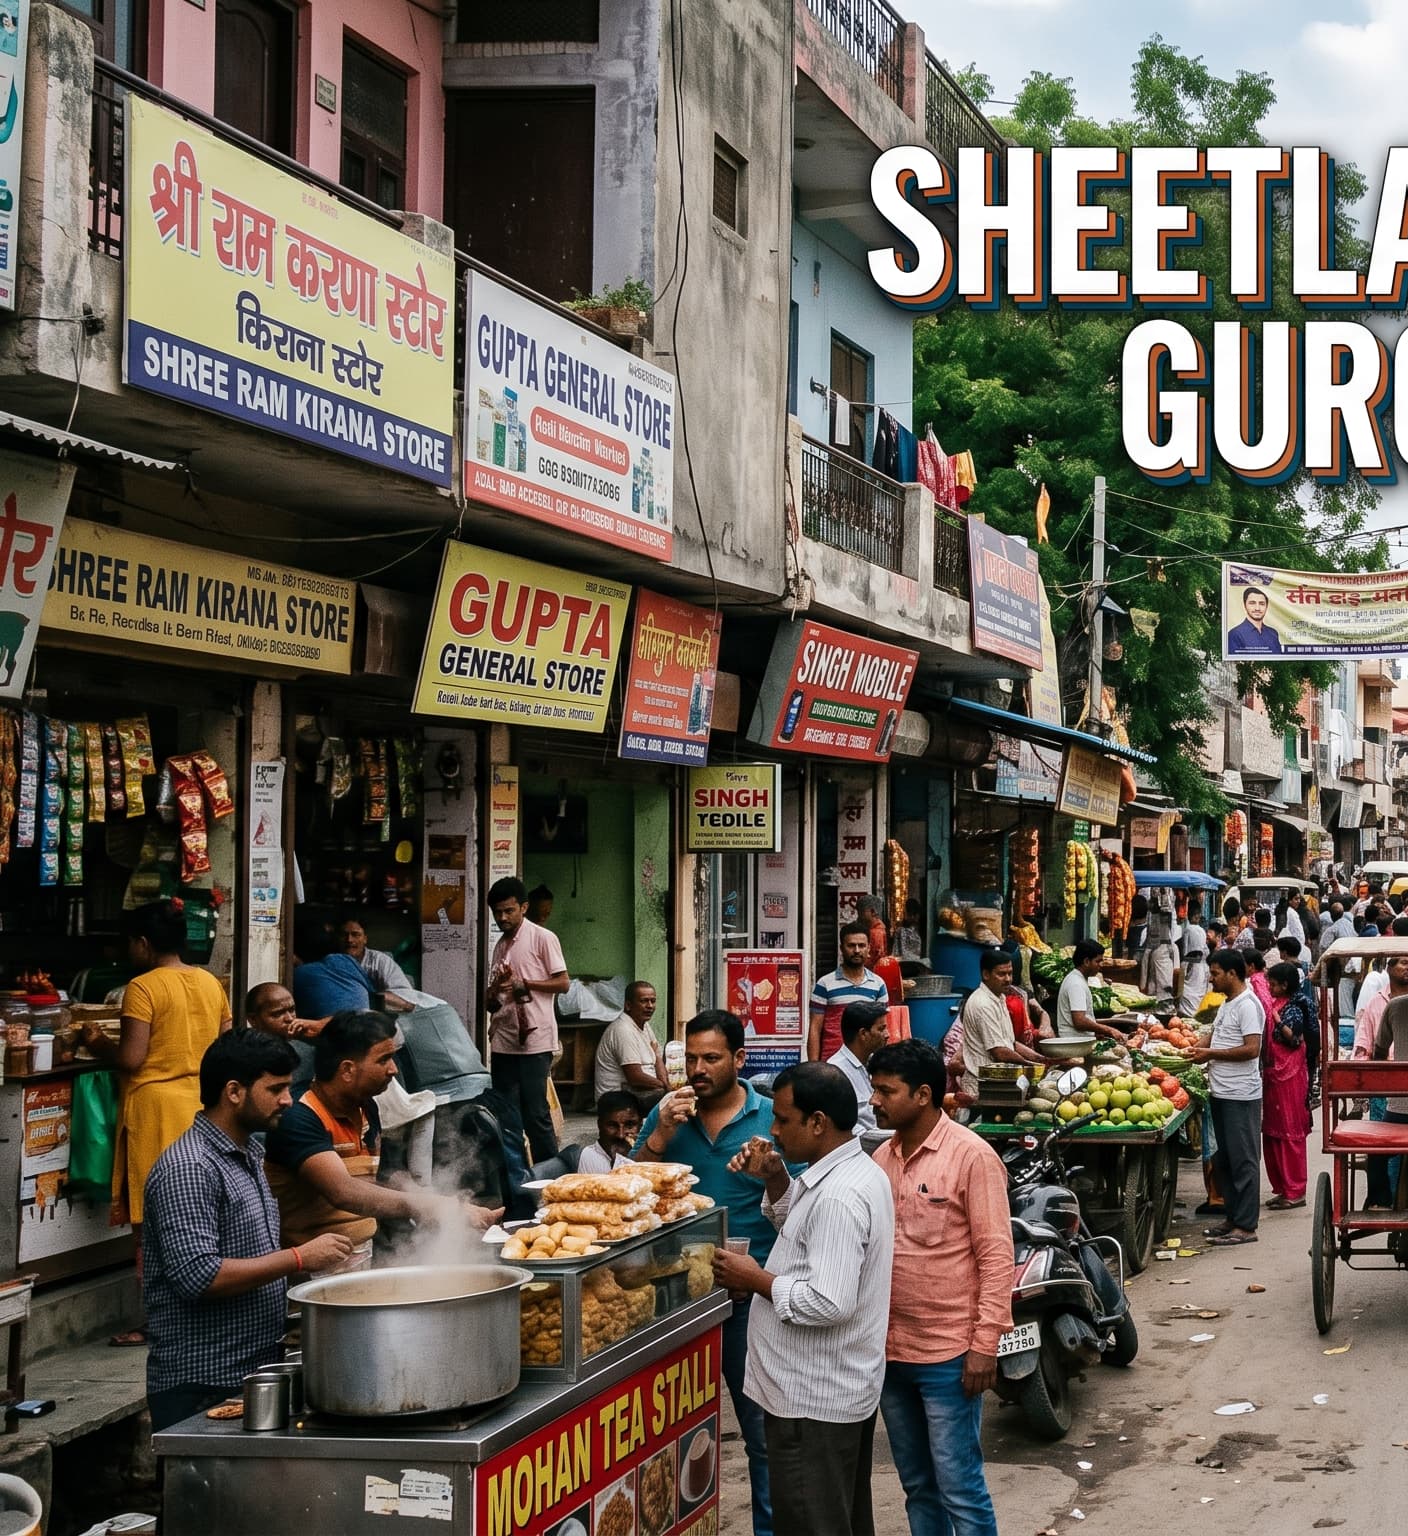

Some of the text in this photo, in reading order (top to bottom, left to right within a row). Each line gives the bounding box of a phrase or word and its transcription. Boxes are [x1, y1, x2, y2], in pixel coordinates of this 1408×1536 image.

[150, 141, 203, 256] श्री
[212, 188, 276, 287] राम
[385, 262, 447, 358] स्टोर
[236, 291, 383, 396] किराना स्टोर
[478, 314, 540, 392] GUPTA
[545, 346, 620, 427] GENERAL
[624, 385, 671, 449] STORE
[144, 336, 445, 473] SHREE RAM KIRANA STORE
[136, 563, 190, 615] RAM
[196, 576, 279, 632] KIRANA
[285, 595, 349, 643] STORE
[448, 571, 614, 662] GUPTA
[439, 642, 607, 697] GENERAL STORE
[797, 639, 913, 703] SINGH MOBILE
[694, 788, 768, 808] SINGH
[487, 1343, 716, 1536] MOHAN TEA STALL
